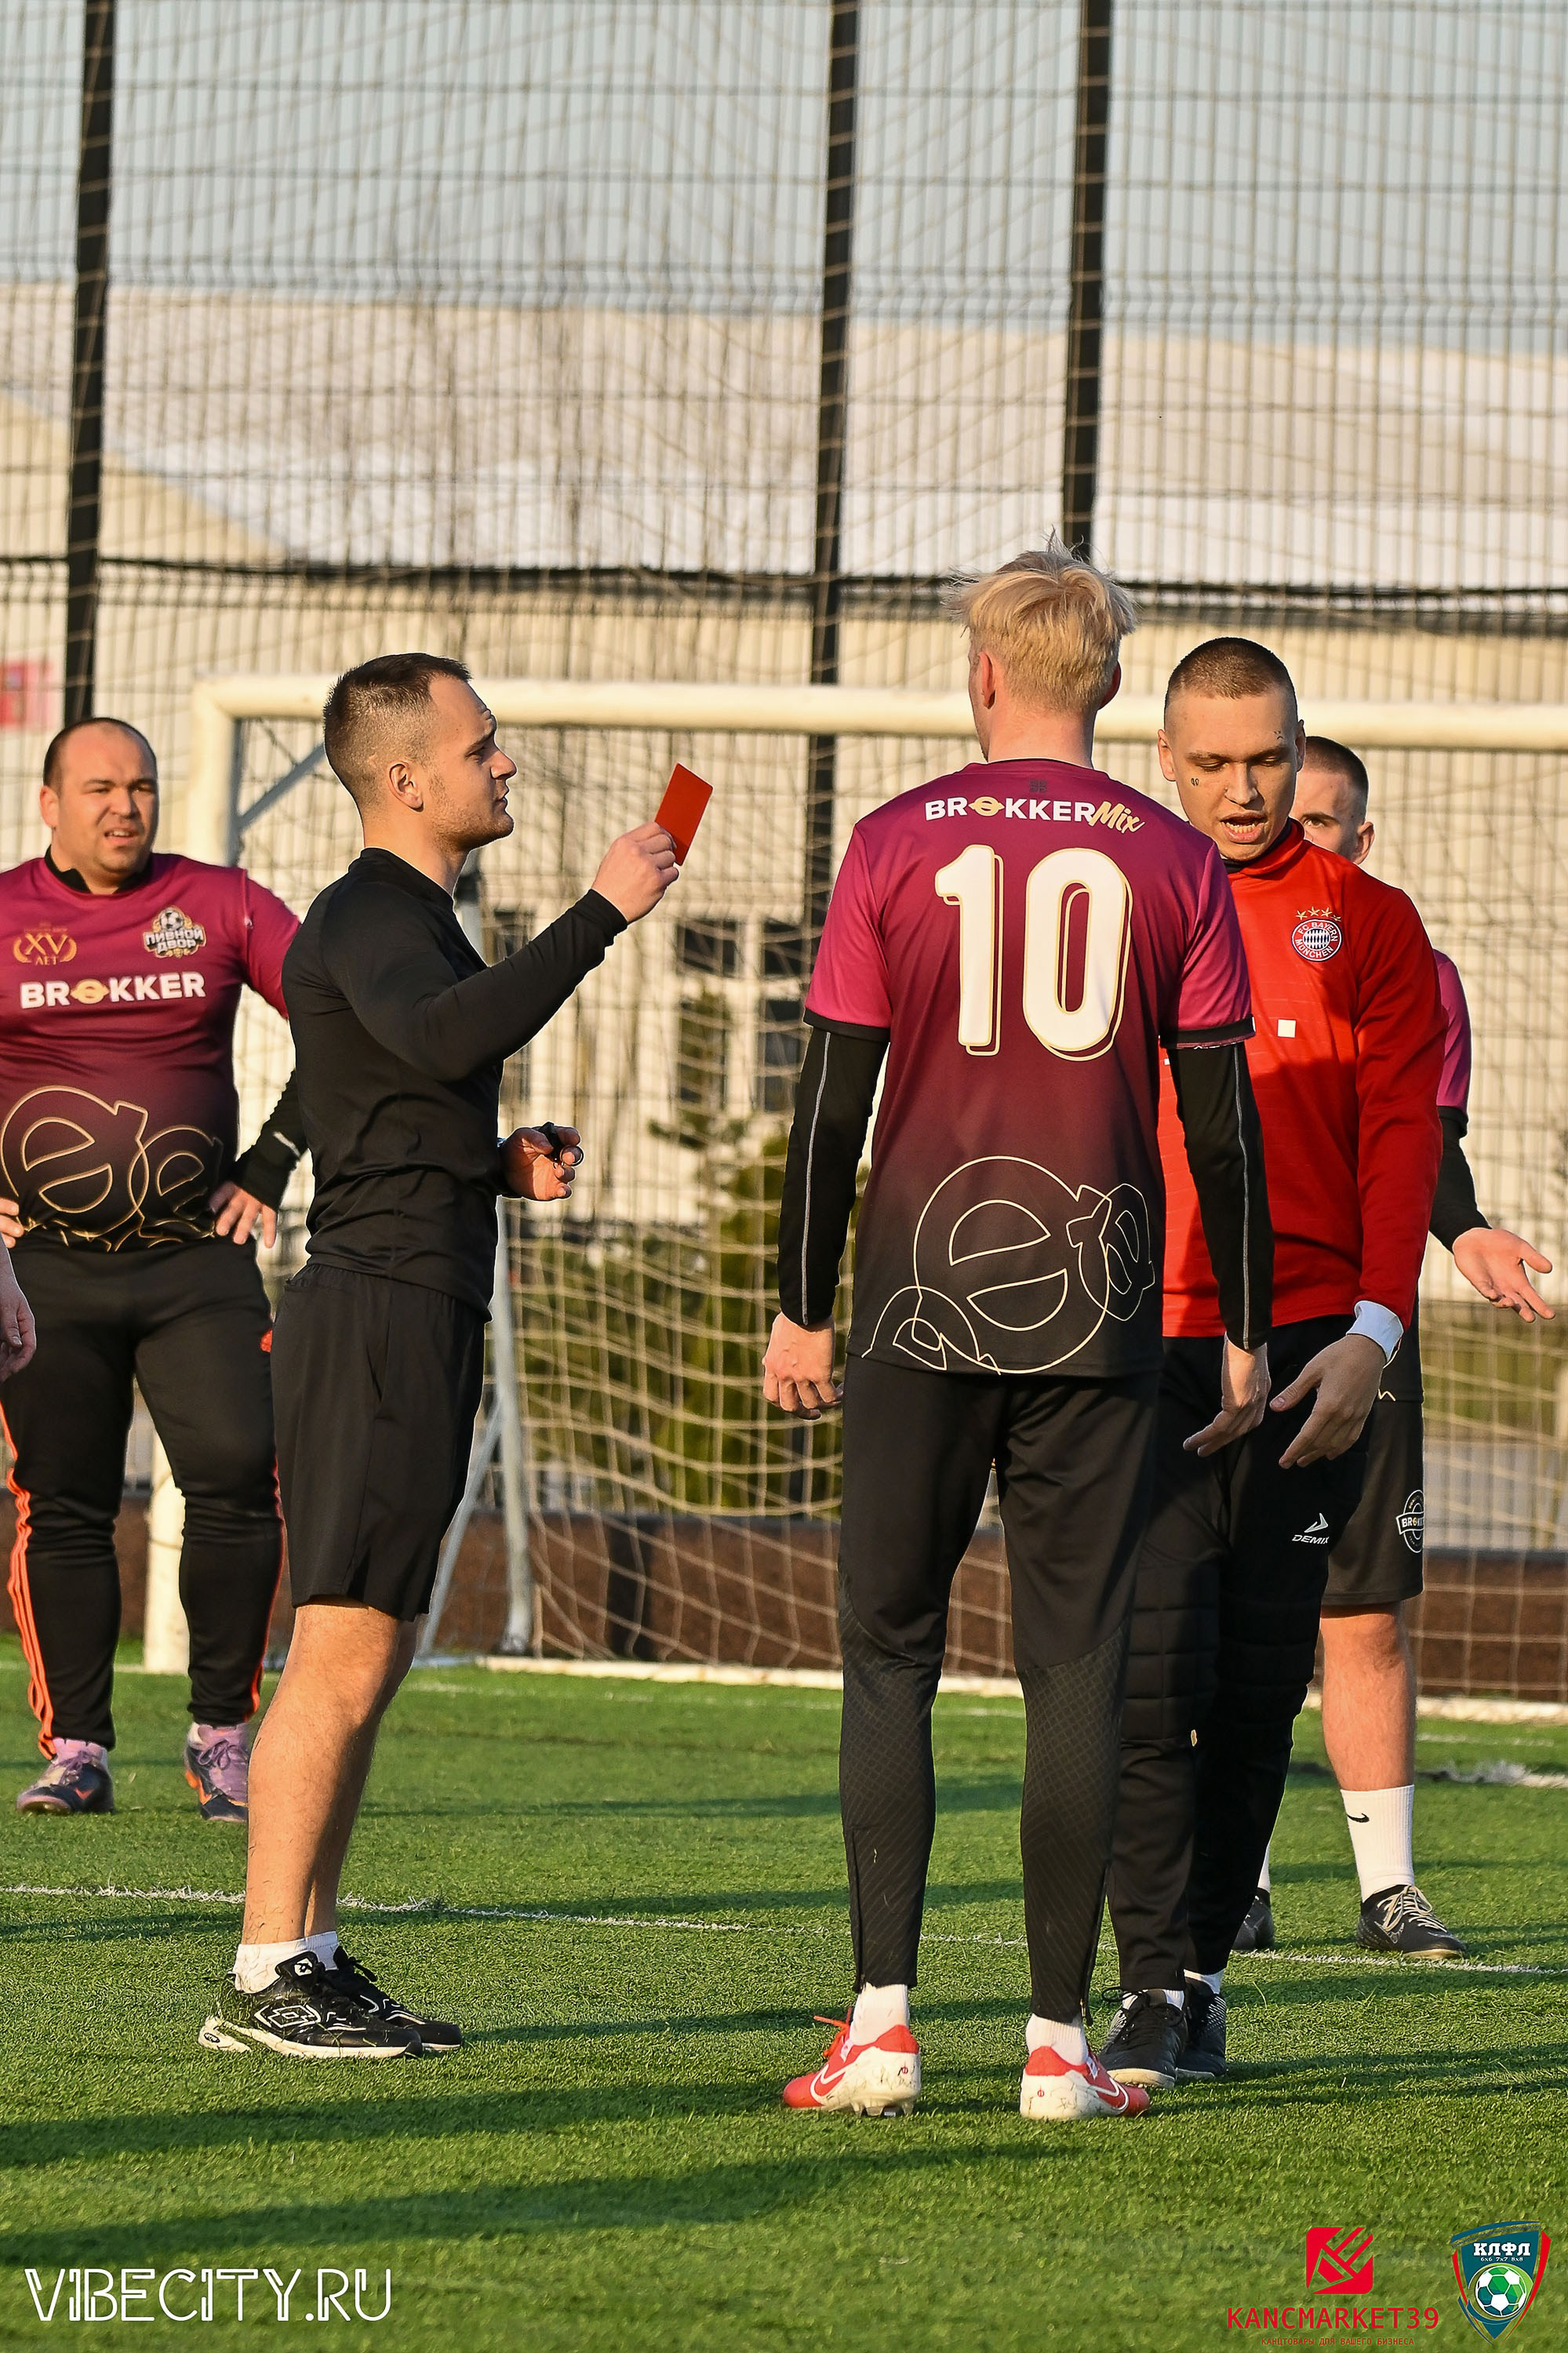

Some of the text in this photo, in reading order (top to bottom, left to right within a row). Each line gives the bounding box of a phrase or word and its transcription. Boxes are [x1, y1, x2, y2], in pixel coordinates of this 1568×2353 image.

[925, 796, 1145, 834] BROKKER Mix
[145, 926, 204, 945] ПИВНОЙ
[1297, 922, 1338, 942] FC BAYERN
[25, 933, 67, 955] XV
[157, 939, 197, 955] ДВОР
[935, 844, 1133, 1061] 10
[20, 971, 206, 1009] BROKKER
[1292, 1534, 1330, 1544] DEMIX
